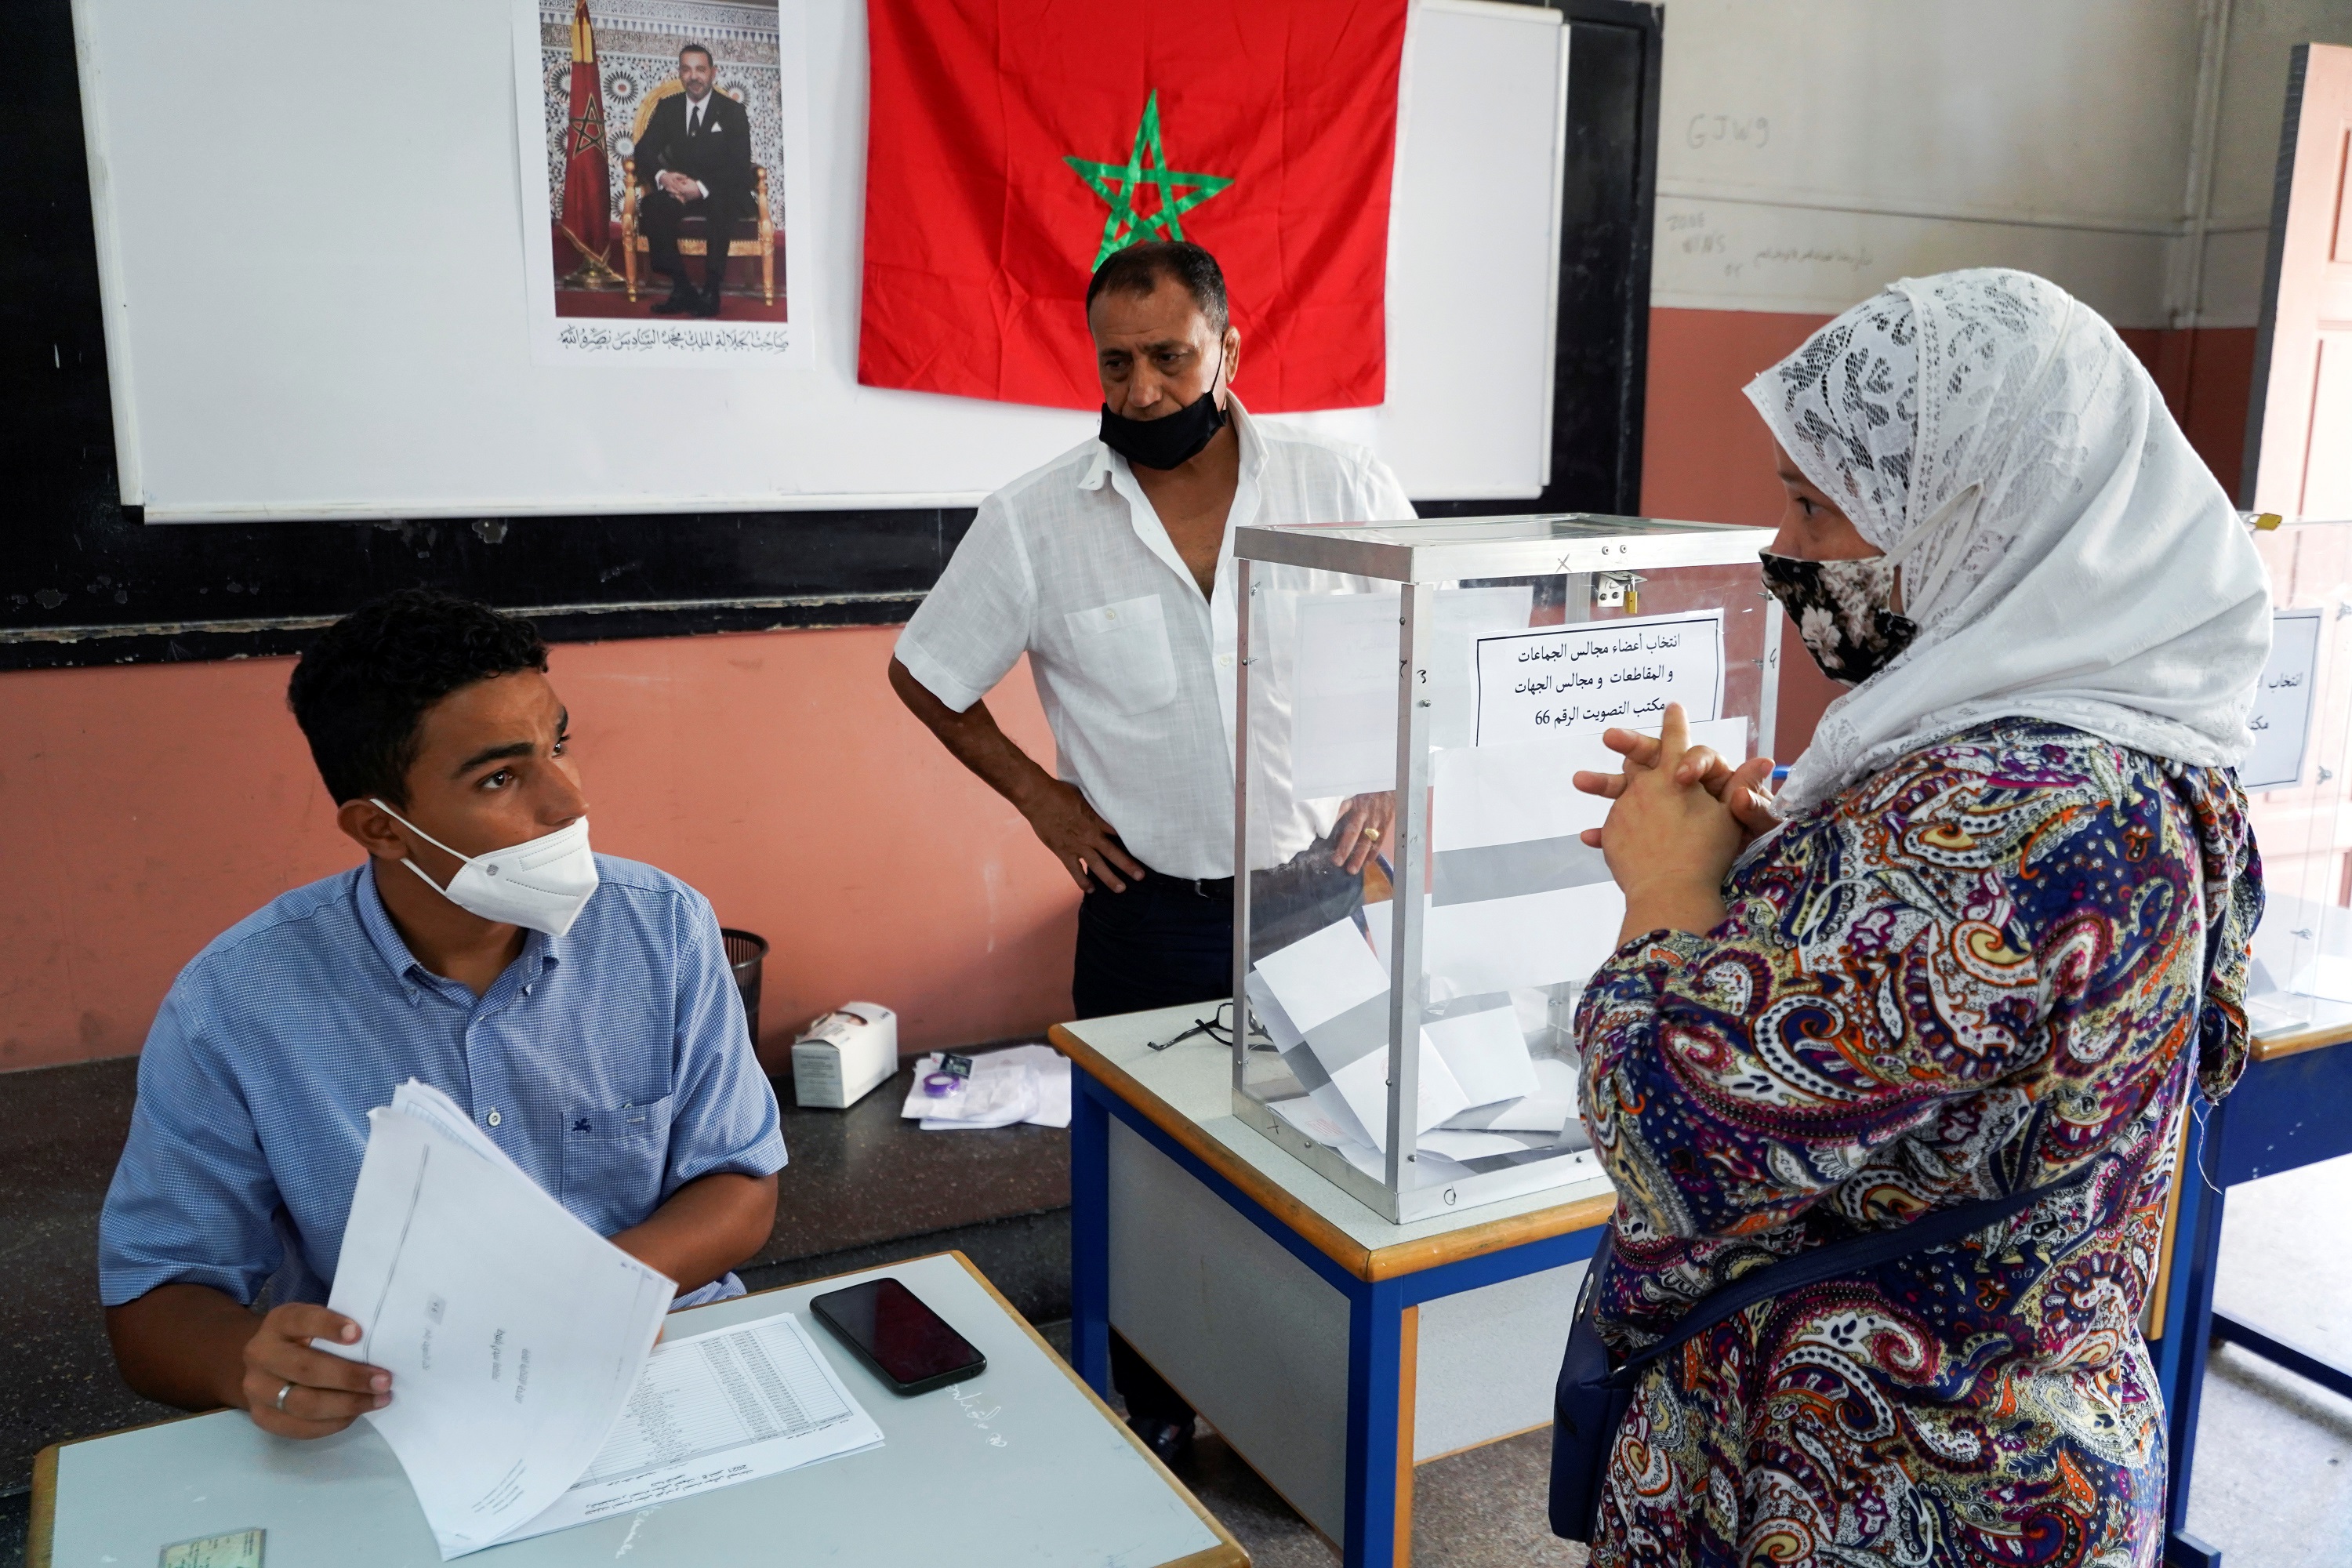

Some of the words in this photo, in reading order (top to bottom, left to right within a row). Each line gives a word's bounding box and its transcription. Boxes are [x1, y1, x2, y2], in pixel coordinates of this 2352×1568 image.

[1570, 641, 1609, 661] مجالس
[1612, 633, 1642, 653] أعضاء
[1646, 633, 1680, 652] انتخاب
[1518, 644, 1567, 662] الجماعات
[1555, 672, 1593, 693] مجالس
[1596, 678, 1603, 688] و
[1610, 665, 1664, 684] المقاطعات
[1667, 670, 1673, 681] و
[1515, 674, 1552, 695] الجهات
[1582, 701, 1630, 722] التصويت
[1633, 697, 1665, 717] مكتب
[1534, 710, 1550, 725] 66
[1554, 706, 1579, 729] الرقم
[2249, 714, 2269, 730] مكت
